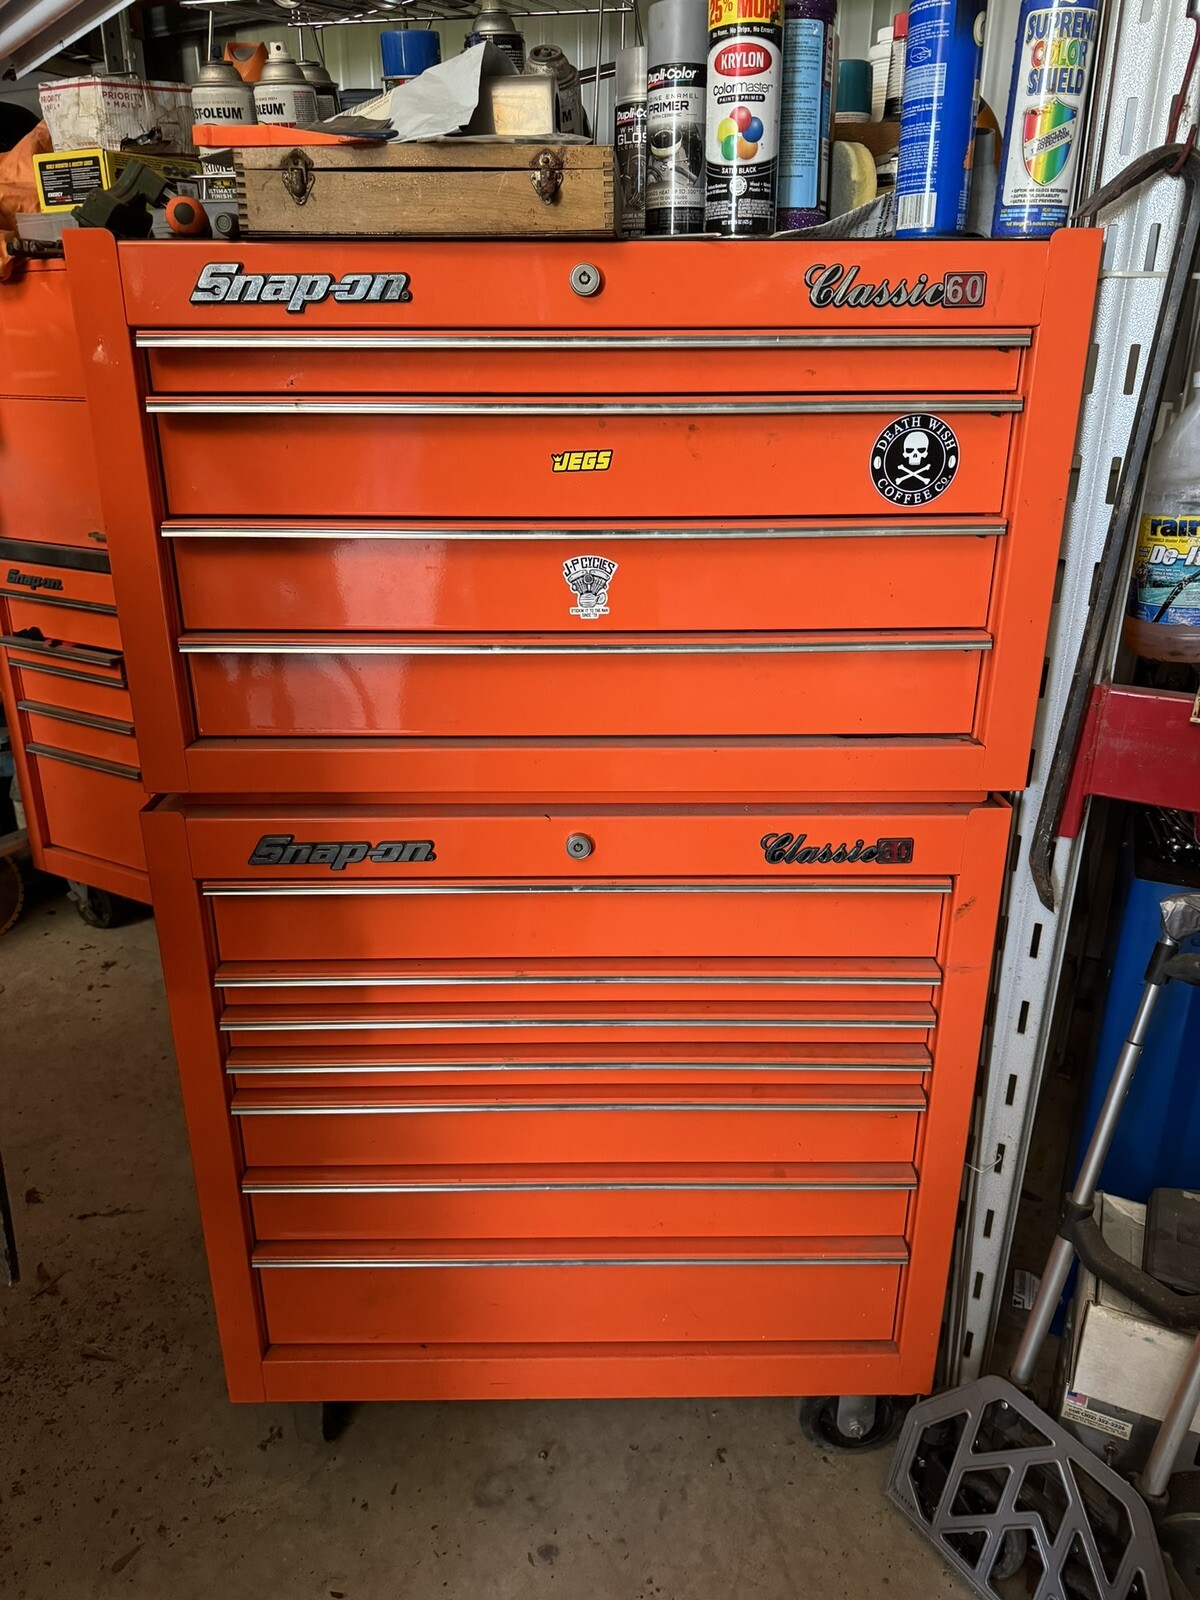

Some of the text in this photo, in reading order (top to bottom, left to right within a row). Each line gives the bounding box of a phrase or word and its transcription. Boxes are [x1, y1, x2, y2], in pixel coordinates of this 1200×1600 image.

[1027, 10, 1096, 44] SUPREM
[721, 52, 764, 70] KRYLON
[1031, 40, 1088, 68] COLOR
[1027, 68, 1085, 95] SHIELD
[102, 91, 144, 101] PRIORITY
[648, 101, 689, 115] PRIMER
[190, 262, 409, 314] Snap-on
[804, 263, 987, 308] Classic 60
[876, 416, 957, 451] DEATH WISH
[552, 449, 613, 472] JEGS
[877, 478, 932, 504] COFFEE
[6, 568, 63, 591] Snap-on
[580, 556, 616, 576] CYCLES
[248, 834, 436, 870] Snap-on
[760, 833, 878, 864] Classic
